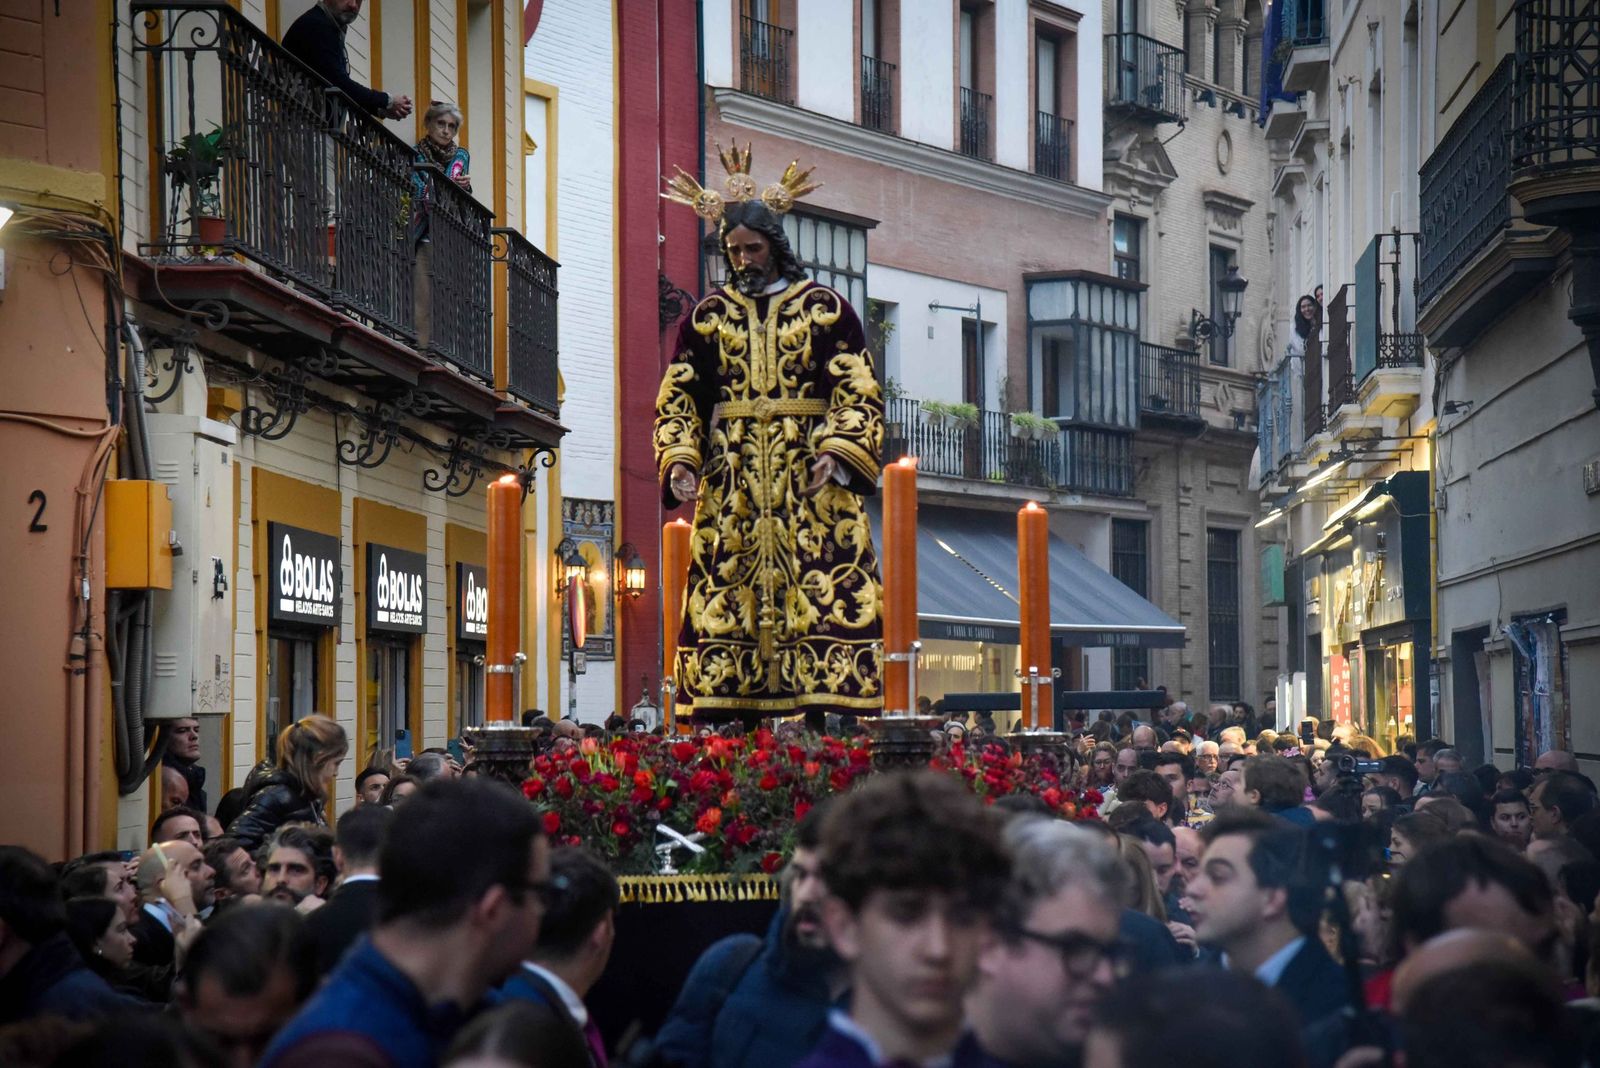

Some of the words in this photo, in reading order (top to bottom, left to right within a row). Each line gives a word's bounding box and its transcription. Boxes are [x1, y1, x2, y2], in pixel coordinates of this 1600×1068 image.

[28, 489, 48, 533] 2
[295, 553, 334, 603] BOLAS
[389, 570, 423, 613] BOLAS
[1332, 674, 1341, 723] RAPI
